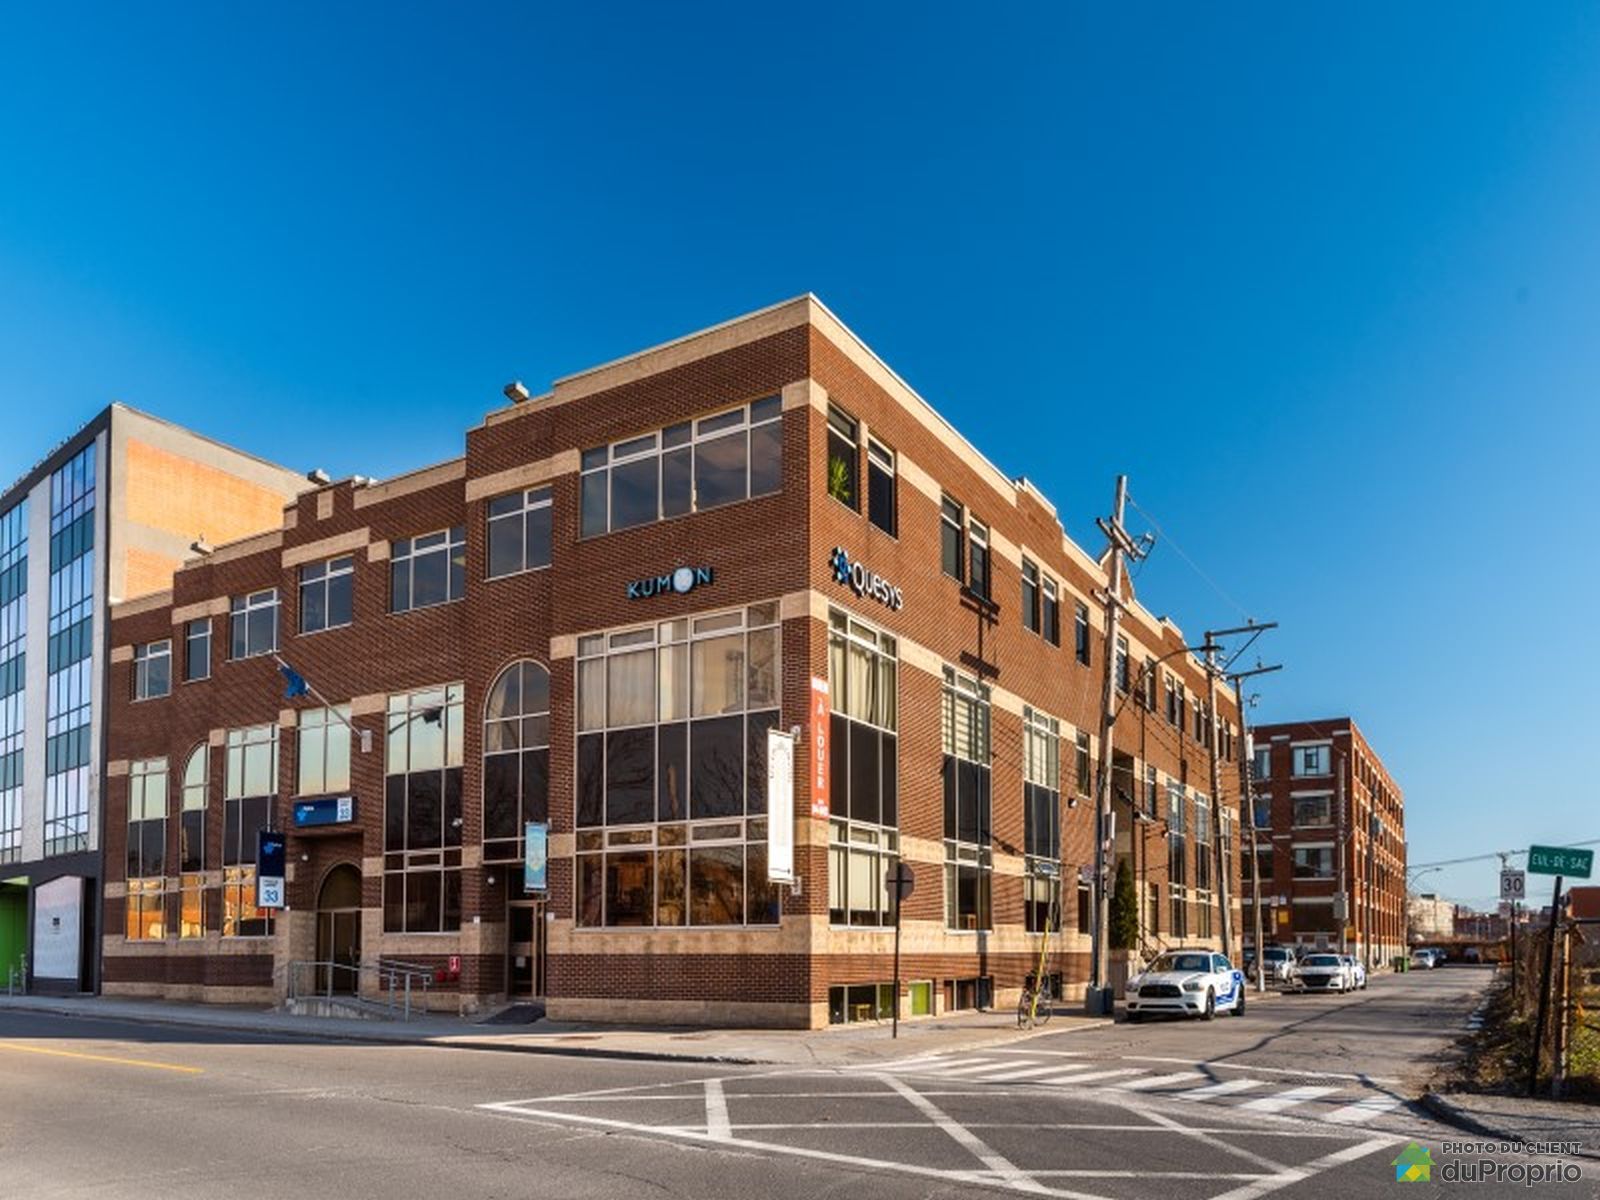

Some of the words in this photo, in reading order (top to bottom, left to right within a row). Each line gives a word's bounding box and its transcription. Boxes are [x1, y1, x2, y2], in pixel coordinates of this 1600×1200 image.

[627, 567, 712, 599] KUMON
[816, 722, 825, 789] LOUER
[1503, 878, 1522, 892] 30
